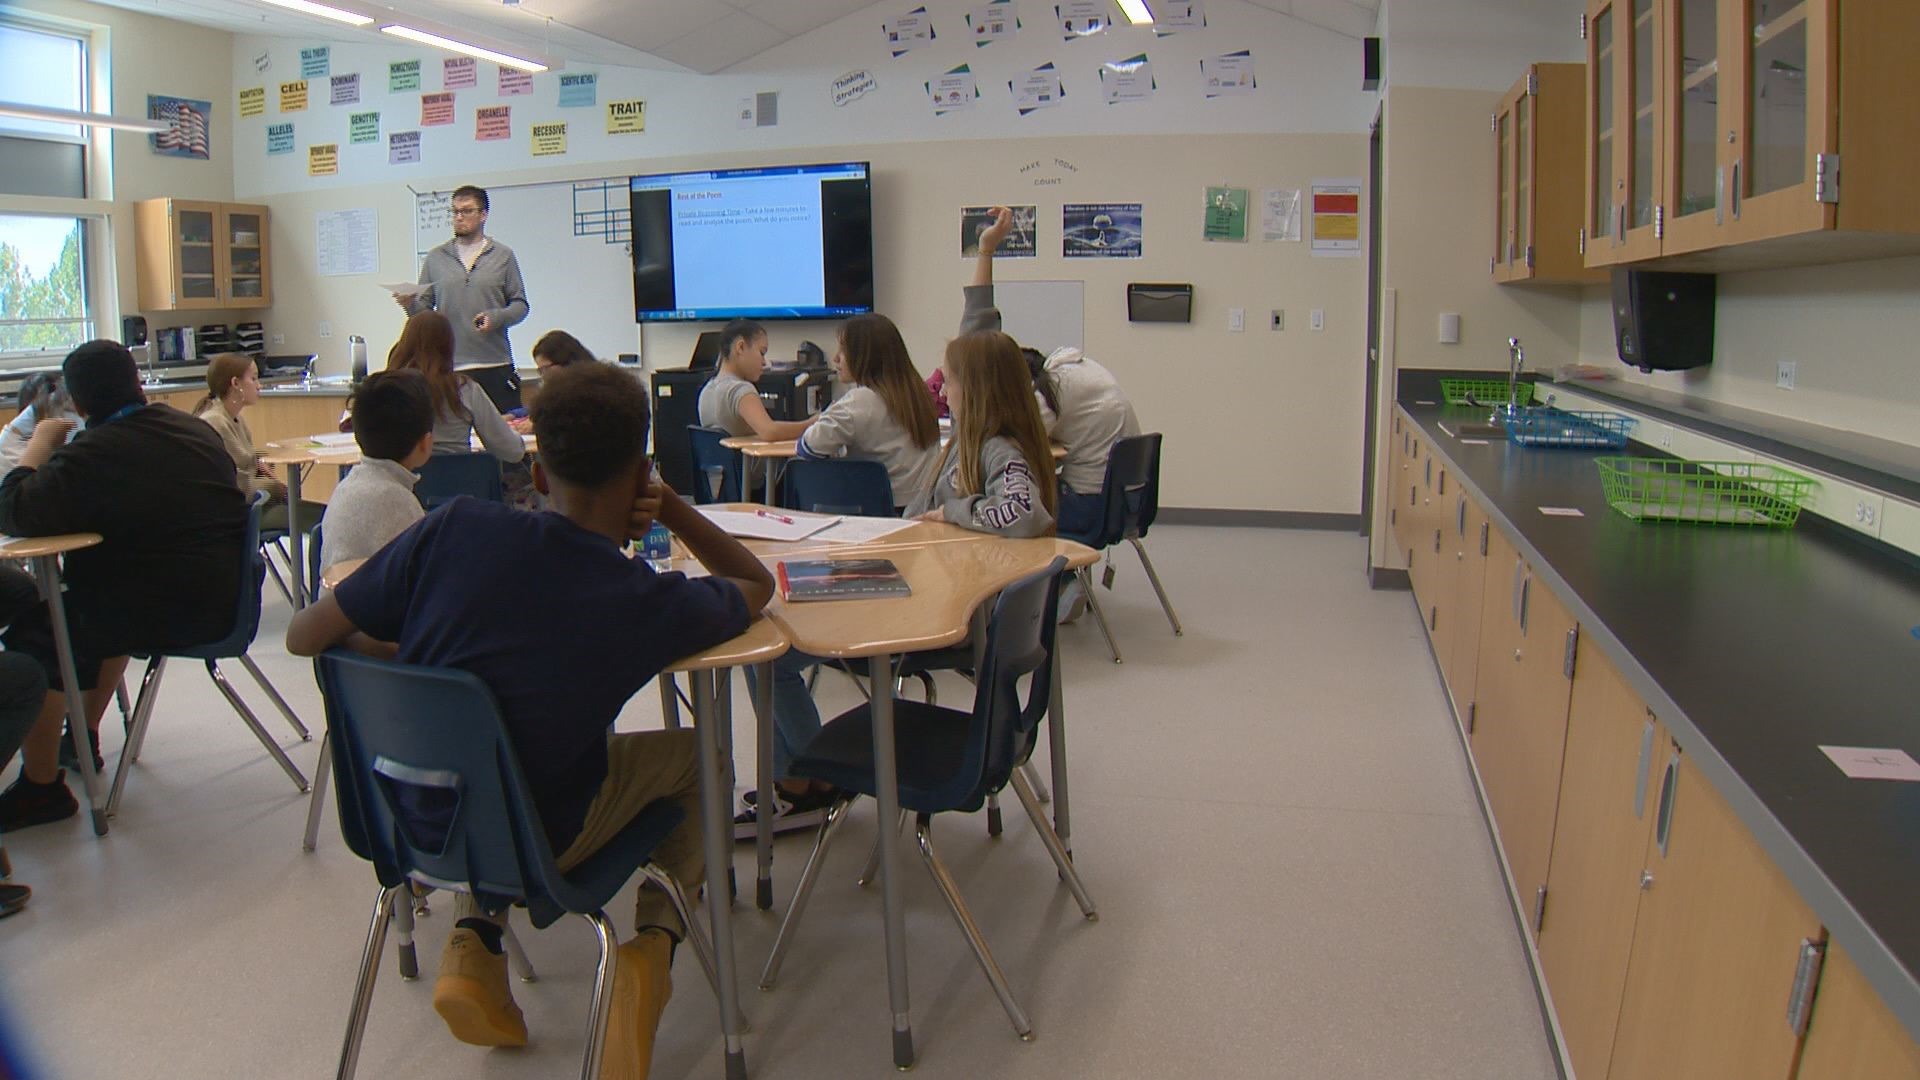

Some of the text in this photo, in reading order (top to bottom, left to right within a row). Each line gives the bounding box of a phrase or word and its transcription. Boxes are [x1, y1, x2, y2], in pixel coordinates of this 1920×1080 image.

[836, 71, 865, 89] Thinking
[280, 82, 307, 93] CELL
[836, 79, 873, 102] Strategies
[477, 106, 509, 119] ORGANELLE
[609, 101, 643, 115] TRAIT
[351, 112, 379, 125] GENOTYPE
[268, 123, 293, 135] ALLELES
[533, 124, 566, 136] RECESSIVE
[1020, 158, 1078, 173] MAKE TODAY
[1034, 177, 1061, 185] COUNT
